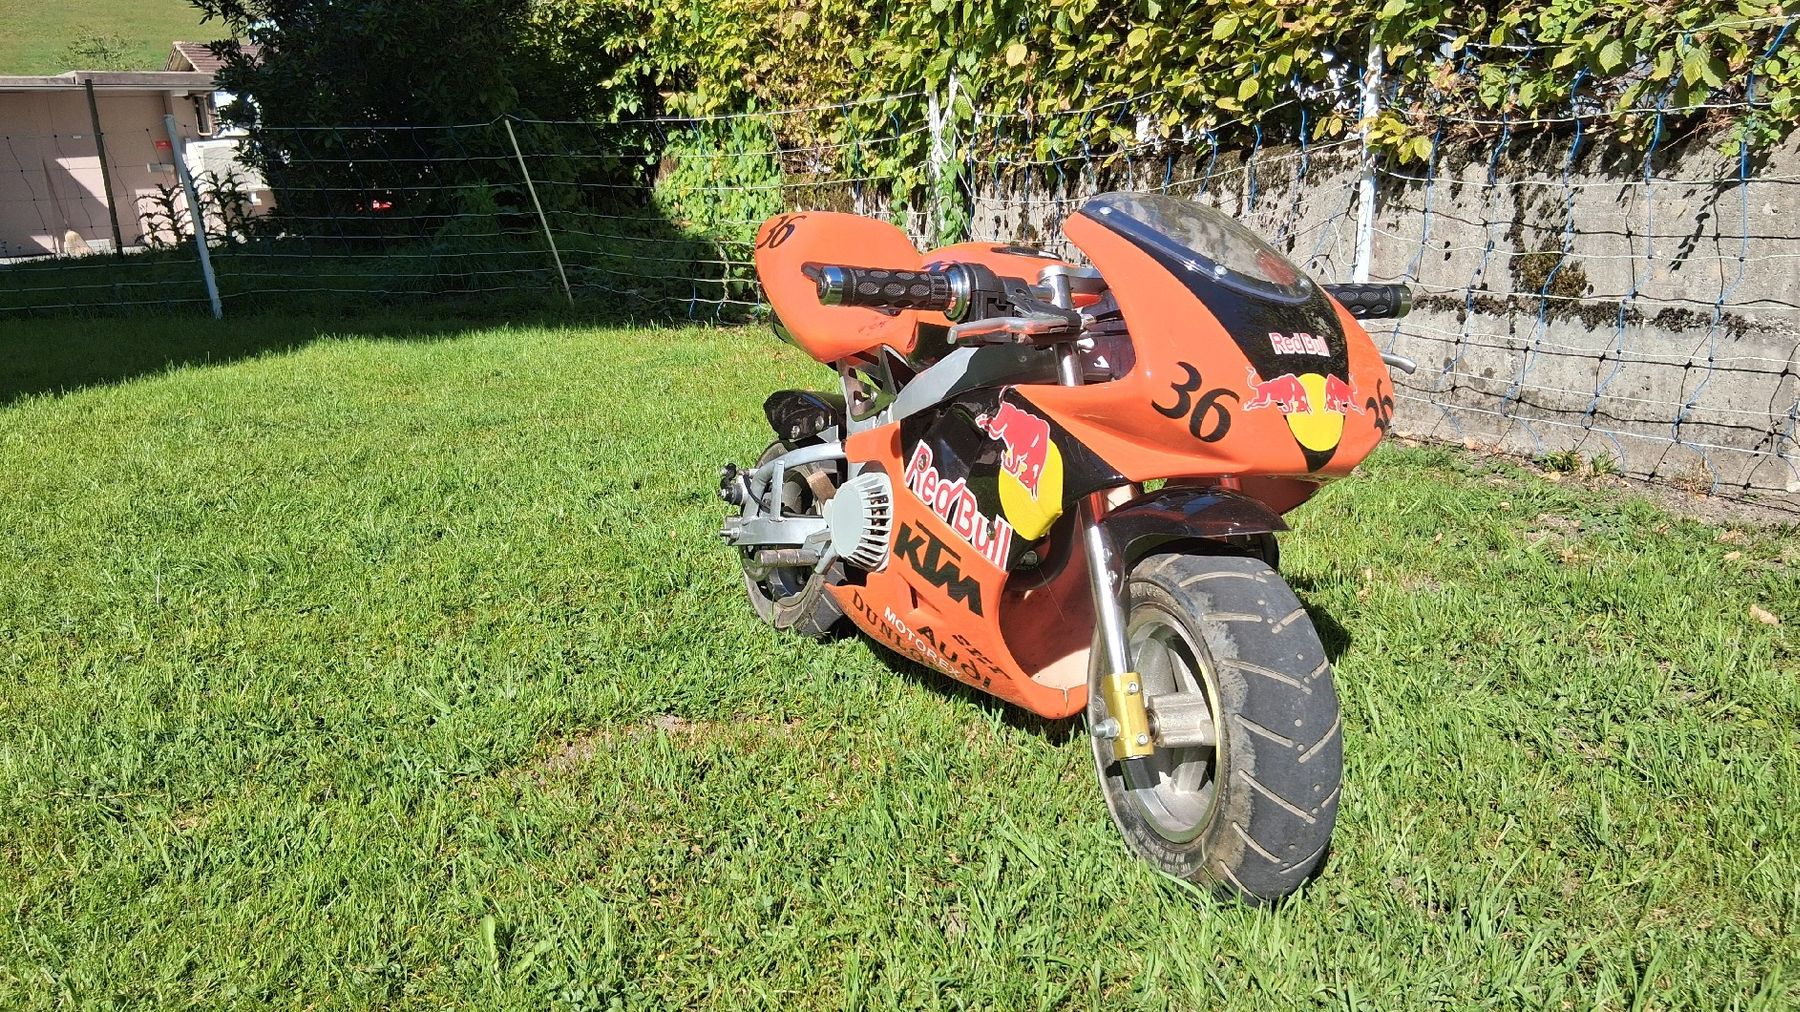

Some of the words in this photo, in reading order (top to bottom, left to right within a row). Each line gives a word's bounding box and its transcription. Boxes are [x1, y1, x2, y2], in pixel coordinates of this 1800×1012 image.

[756, 214, 807, 249] 36
[1268, 332, 1306, 355] Red
[1300, 332, 1331, 357] Bull
[1152, 361, 1240, 443] 36
[905, 439, 966, 521] Red
[951, 487, 1014, 572] Bull
[893, 519, 984, 618] KTM
[884, 606, 960, 678] MOTOREX
